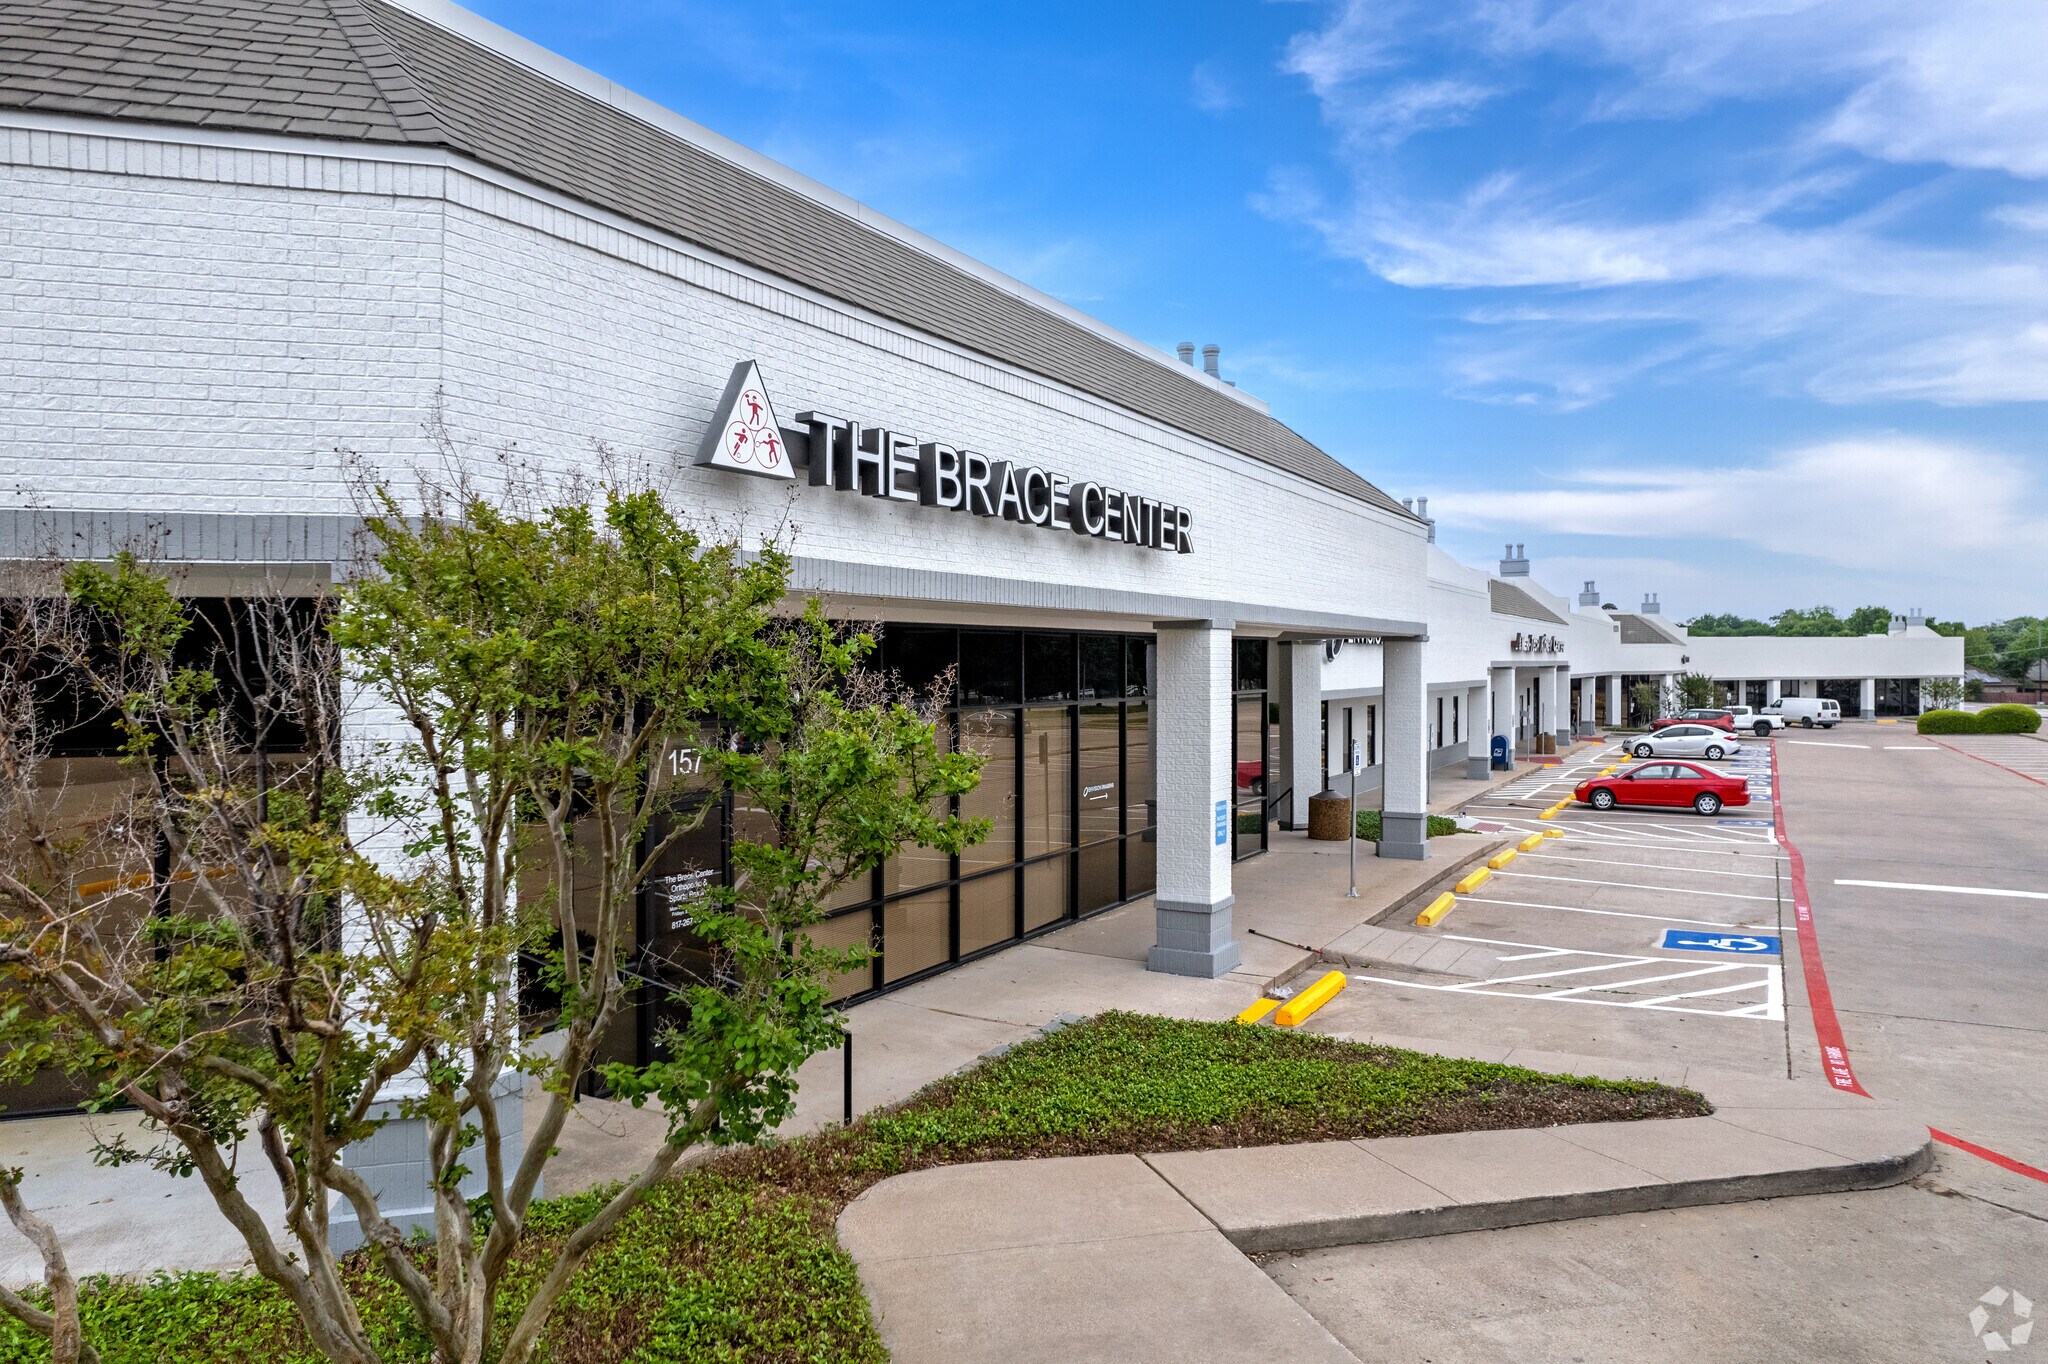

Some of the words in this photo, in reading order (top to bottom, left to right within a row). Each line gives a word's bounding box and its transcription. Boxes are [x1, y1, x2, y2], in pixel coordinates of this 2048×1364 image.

[803, 411, 918, 502] THE
[927, 442, 1072, 530] BRACE
[1076, 481, 1195, 554] CENTER
[668, 748, 702, 776] 157
[665, 875, 677, 884] The
[695, 869, 714, 878] Center
